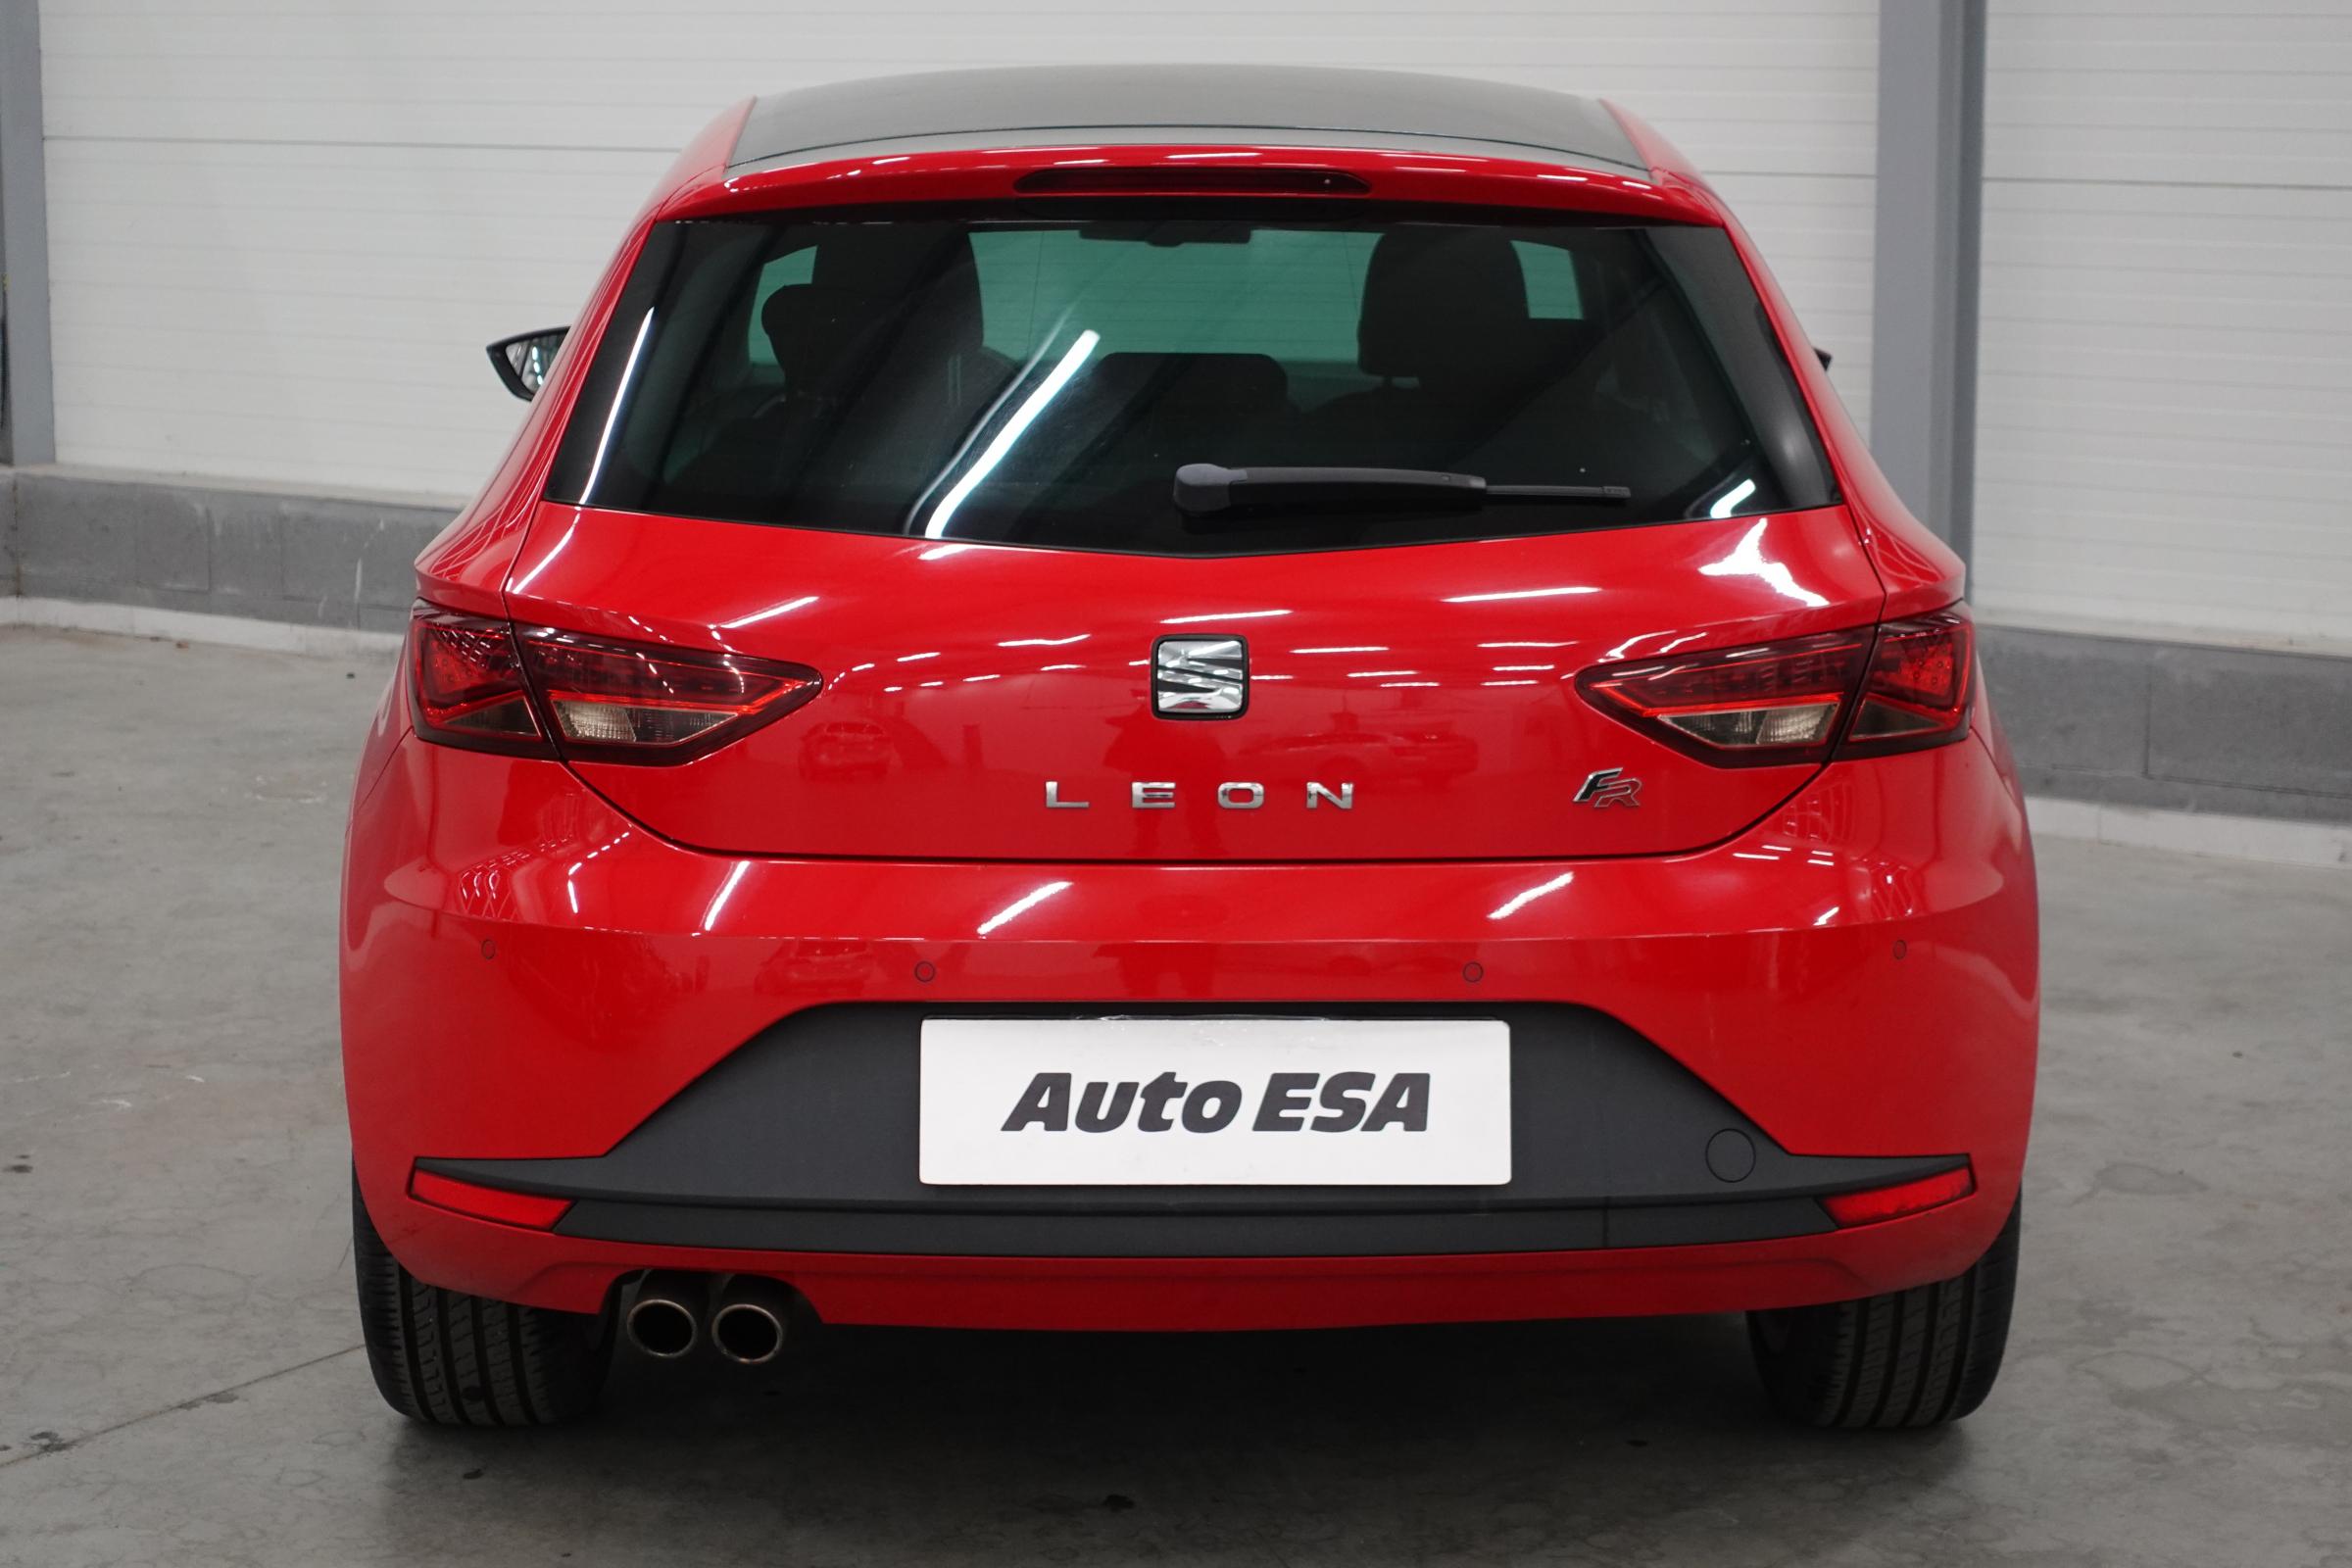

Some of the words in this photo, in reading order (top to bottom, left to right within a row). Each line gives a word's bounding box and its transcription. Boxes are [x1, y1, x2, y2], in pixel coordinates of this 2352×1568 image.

[1046, 780, 1353, 808] LEON
[1573, 766, 1642, 808] FR
[1001, 1071, 1242, 1133] Auto
[1252, 1071, 1431, 1133] ESA
